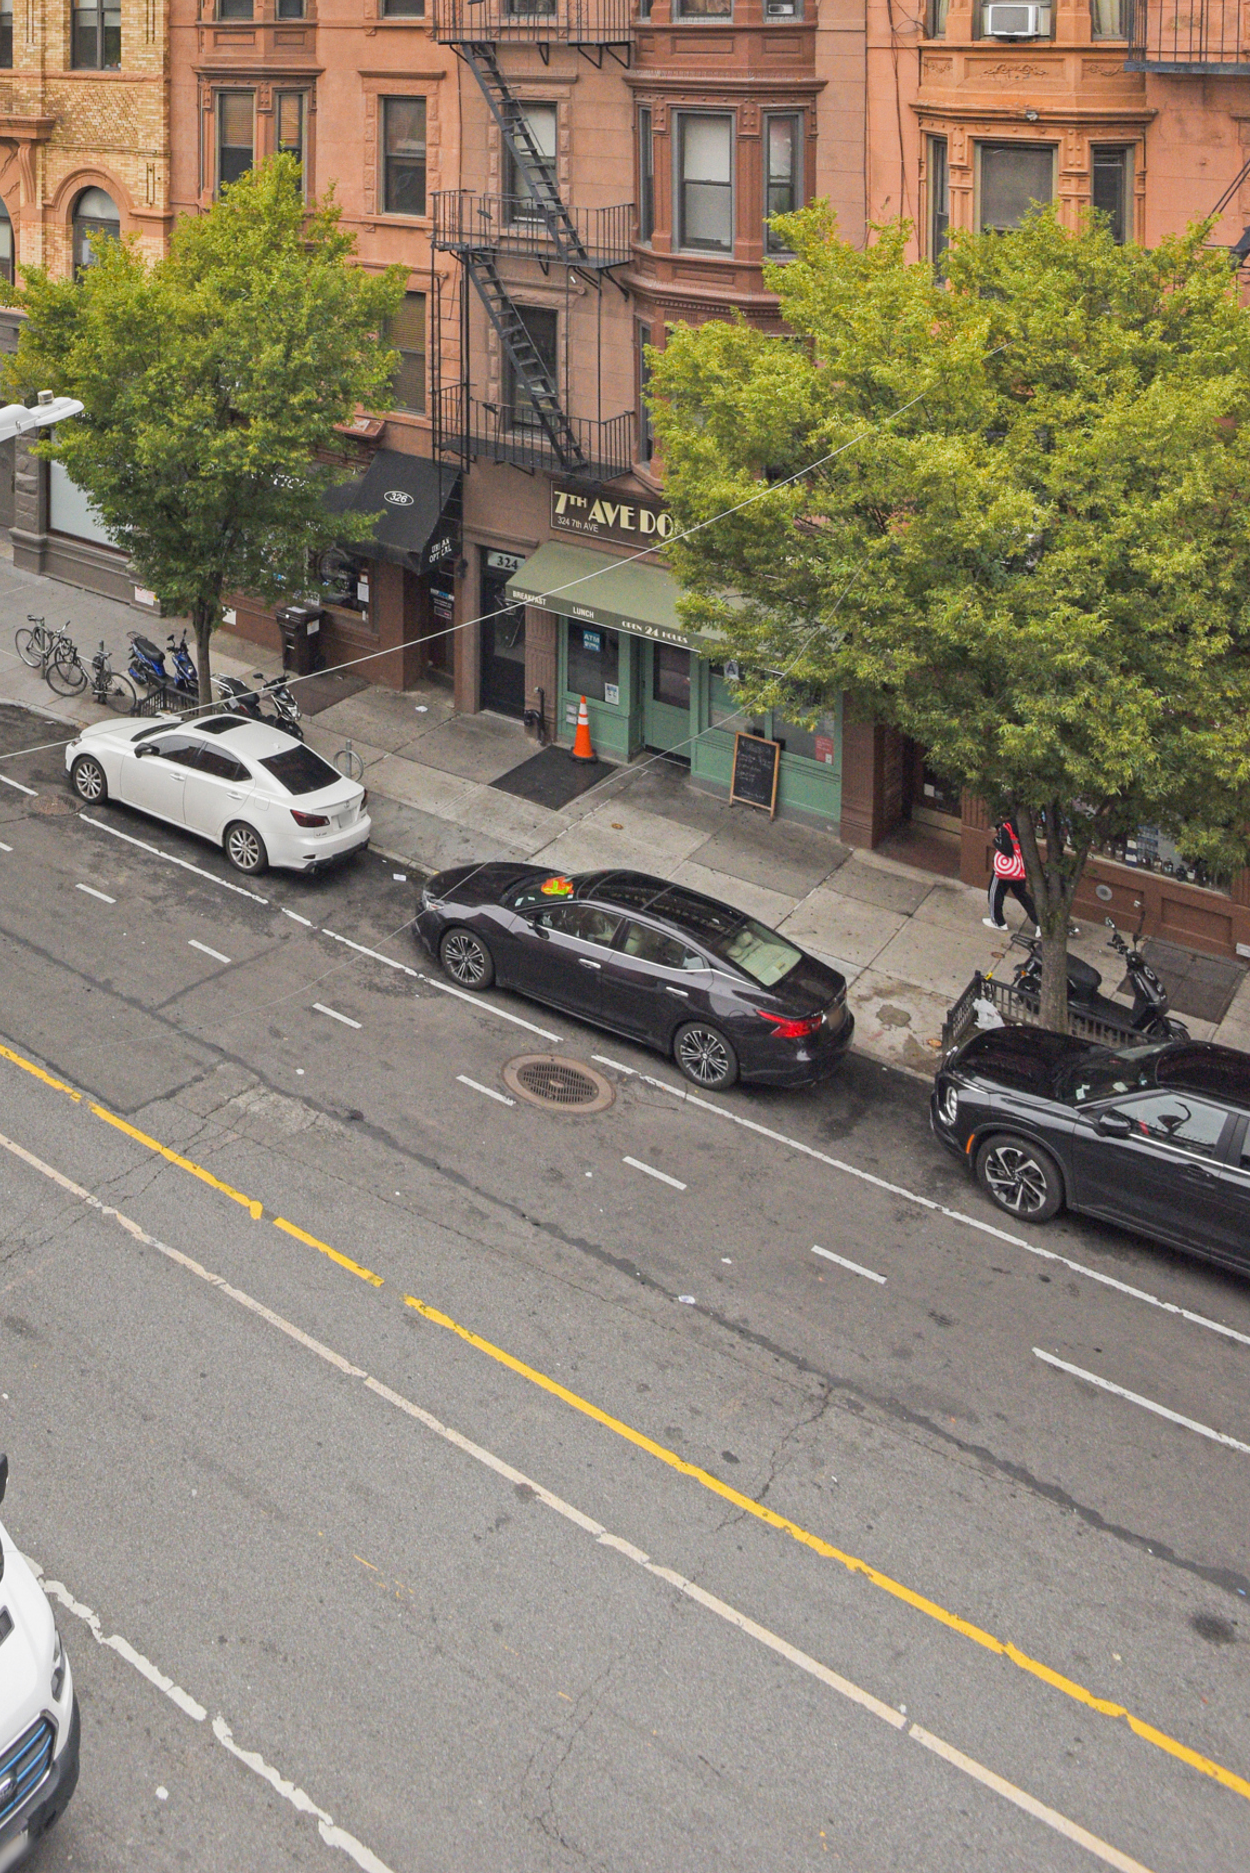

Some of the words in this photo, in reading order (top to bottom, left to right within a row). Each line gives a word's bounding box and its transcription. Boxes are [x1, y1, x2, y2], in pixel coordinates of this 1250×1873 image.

[389, 491, 408, 504] 326
[554, 491, 587, 514] 7TH
[588, 498, 637, 530] AVE
[557, 515, 570, 526] 324
[571, 518, 583, 529] 7th
[583, 522, 599, 533] AVE
[429, 544, 452, 563] OPTCAL
[496, 555, 519, 571] 324
[512, 590, 547, 606] BREAKFAST
[572, 606, 595, 619] LUNCH
[584, 633, 600, 643] ATM
[621, 620, 643, 632] OPEN
[644, 625, 659, 638] 24
[662, 631, 689, 644] HOURS
[726, 662, 737, 675] A
